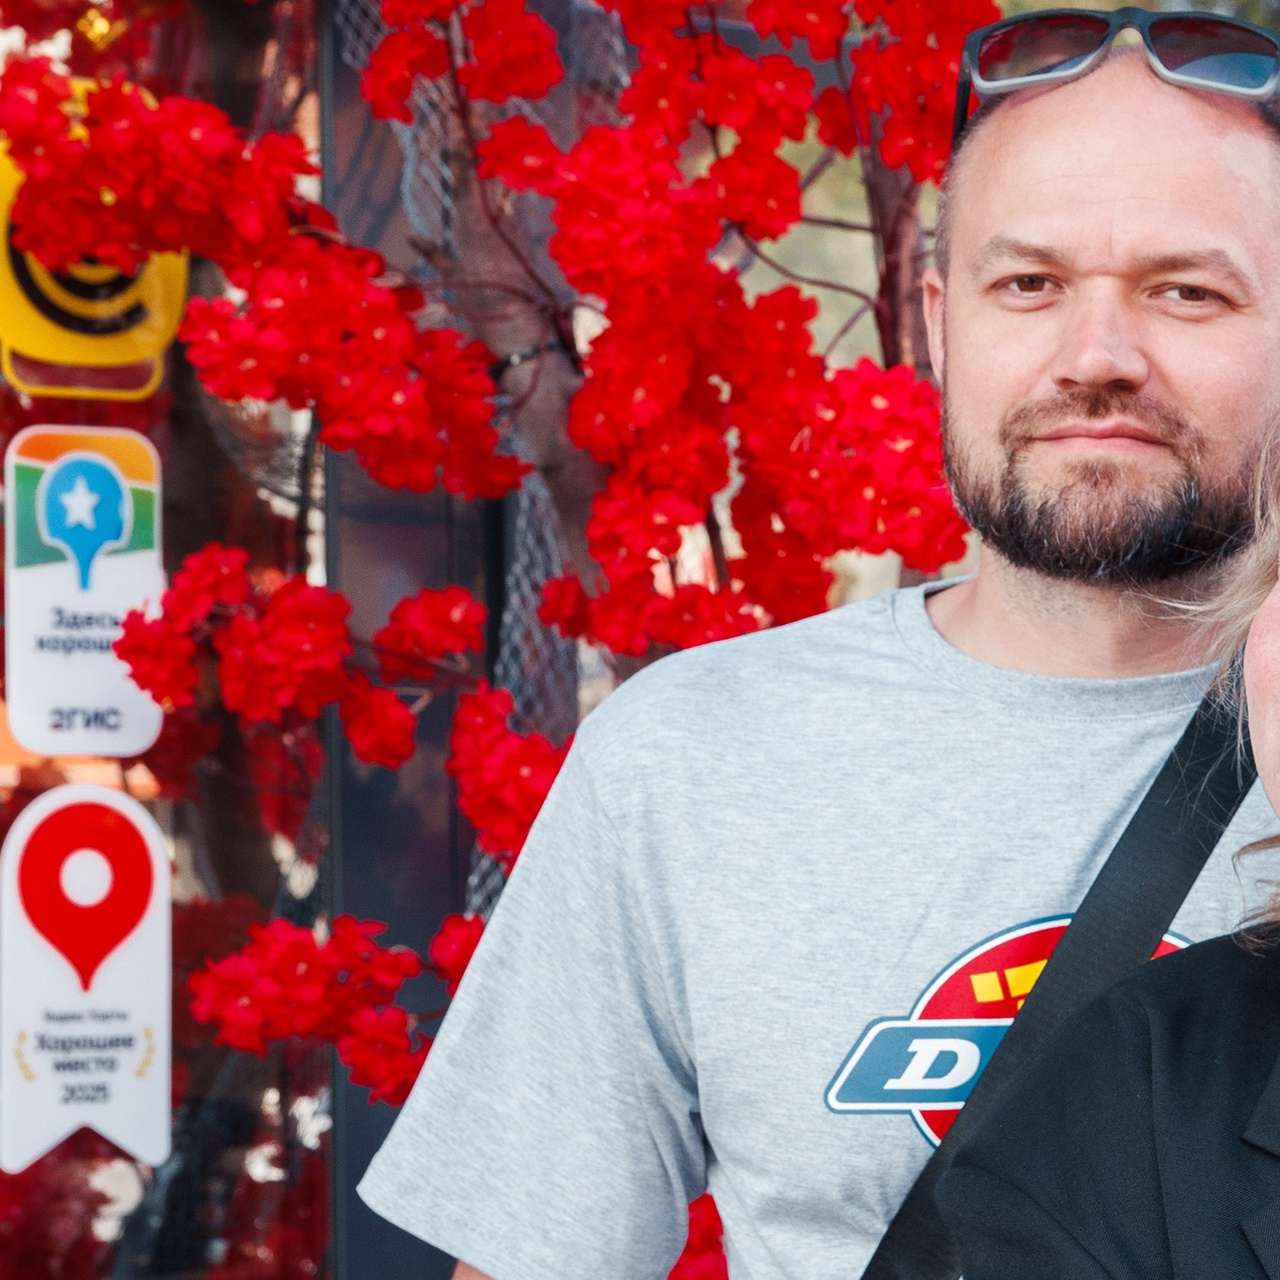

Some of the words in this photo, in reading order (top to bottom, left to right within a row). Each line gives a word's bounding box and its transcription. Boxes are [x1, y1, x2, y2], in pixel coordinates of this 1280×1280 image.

[36, 637, 112, 657] хорош
[50, 708, 122, 731] 2ГИС
[35, 1032, 135, 1052] Хорошее
